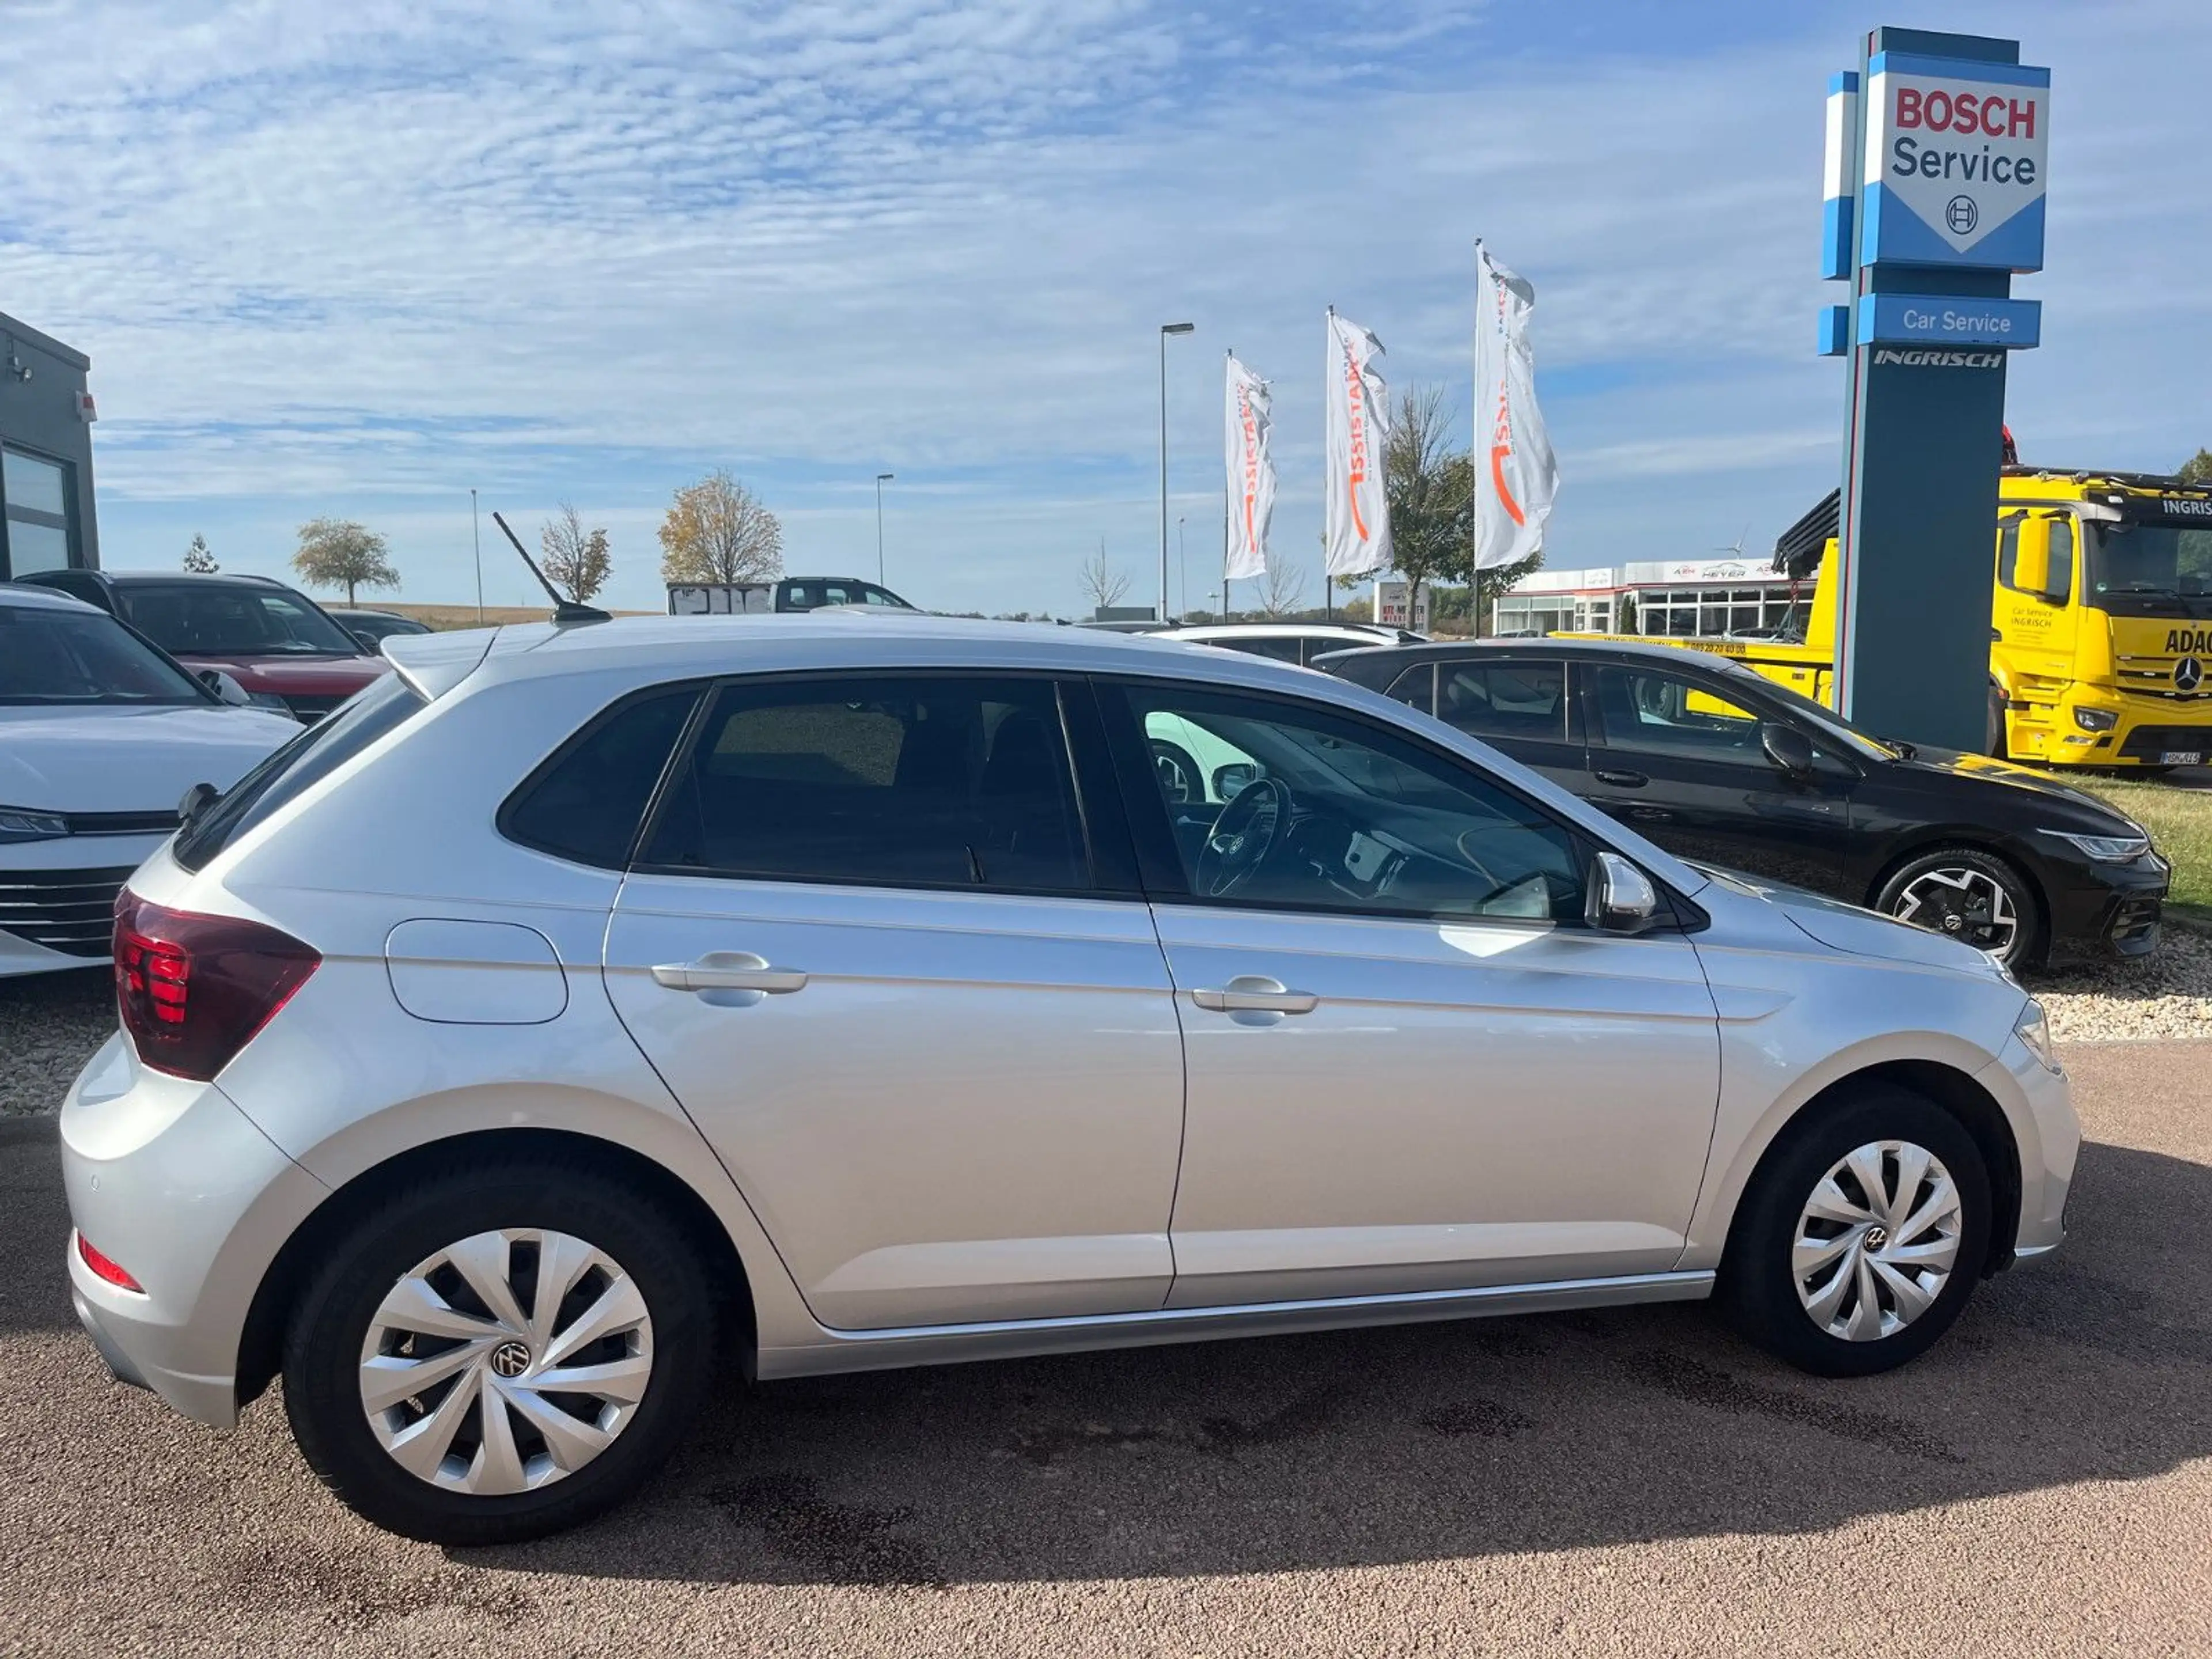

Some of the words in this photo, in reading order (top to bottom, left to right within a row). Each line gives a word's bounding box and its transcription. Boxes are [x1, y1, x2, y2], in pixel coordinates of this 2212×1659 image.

[1896, 88, 2035, 139] BOSCH
[1892, 137, 2036, 185] Service
[1903, 309, 1936, 329] Car
[1942, 310, 2011, 332] Service
[1874, 350, 2003, 368] INGRISCH
[2011, 617, 2052, 628] INGRISCH
